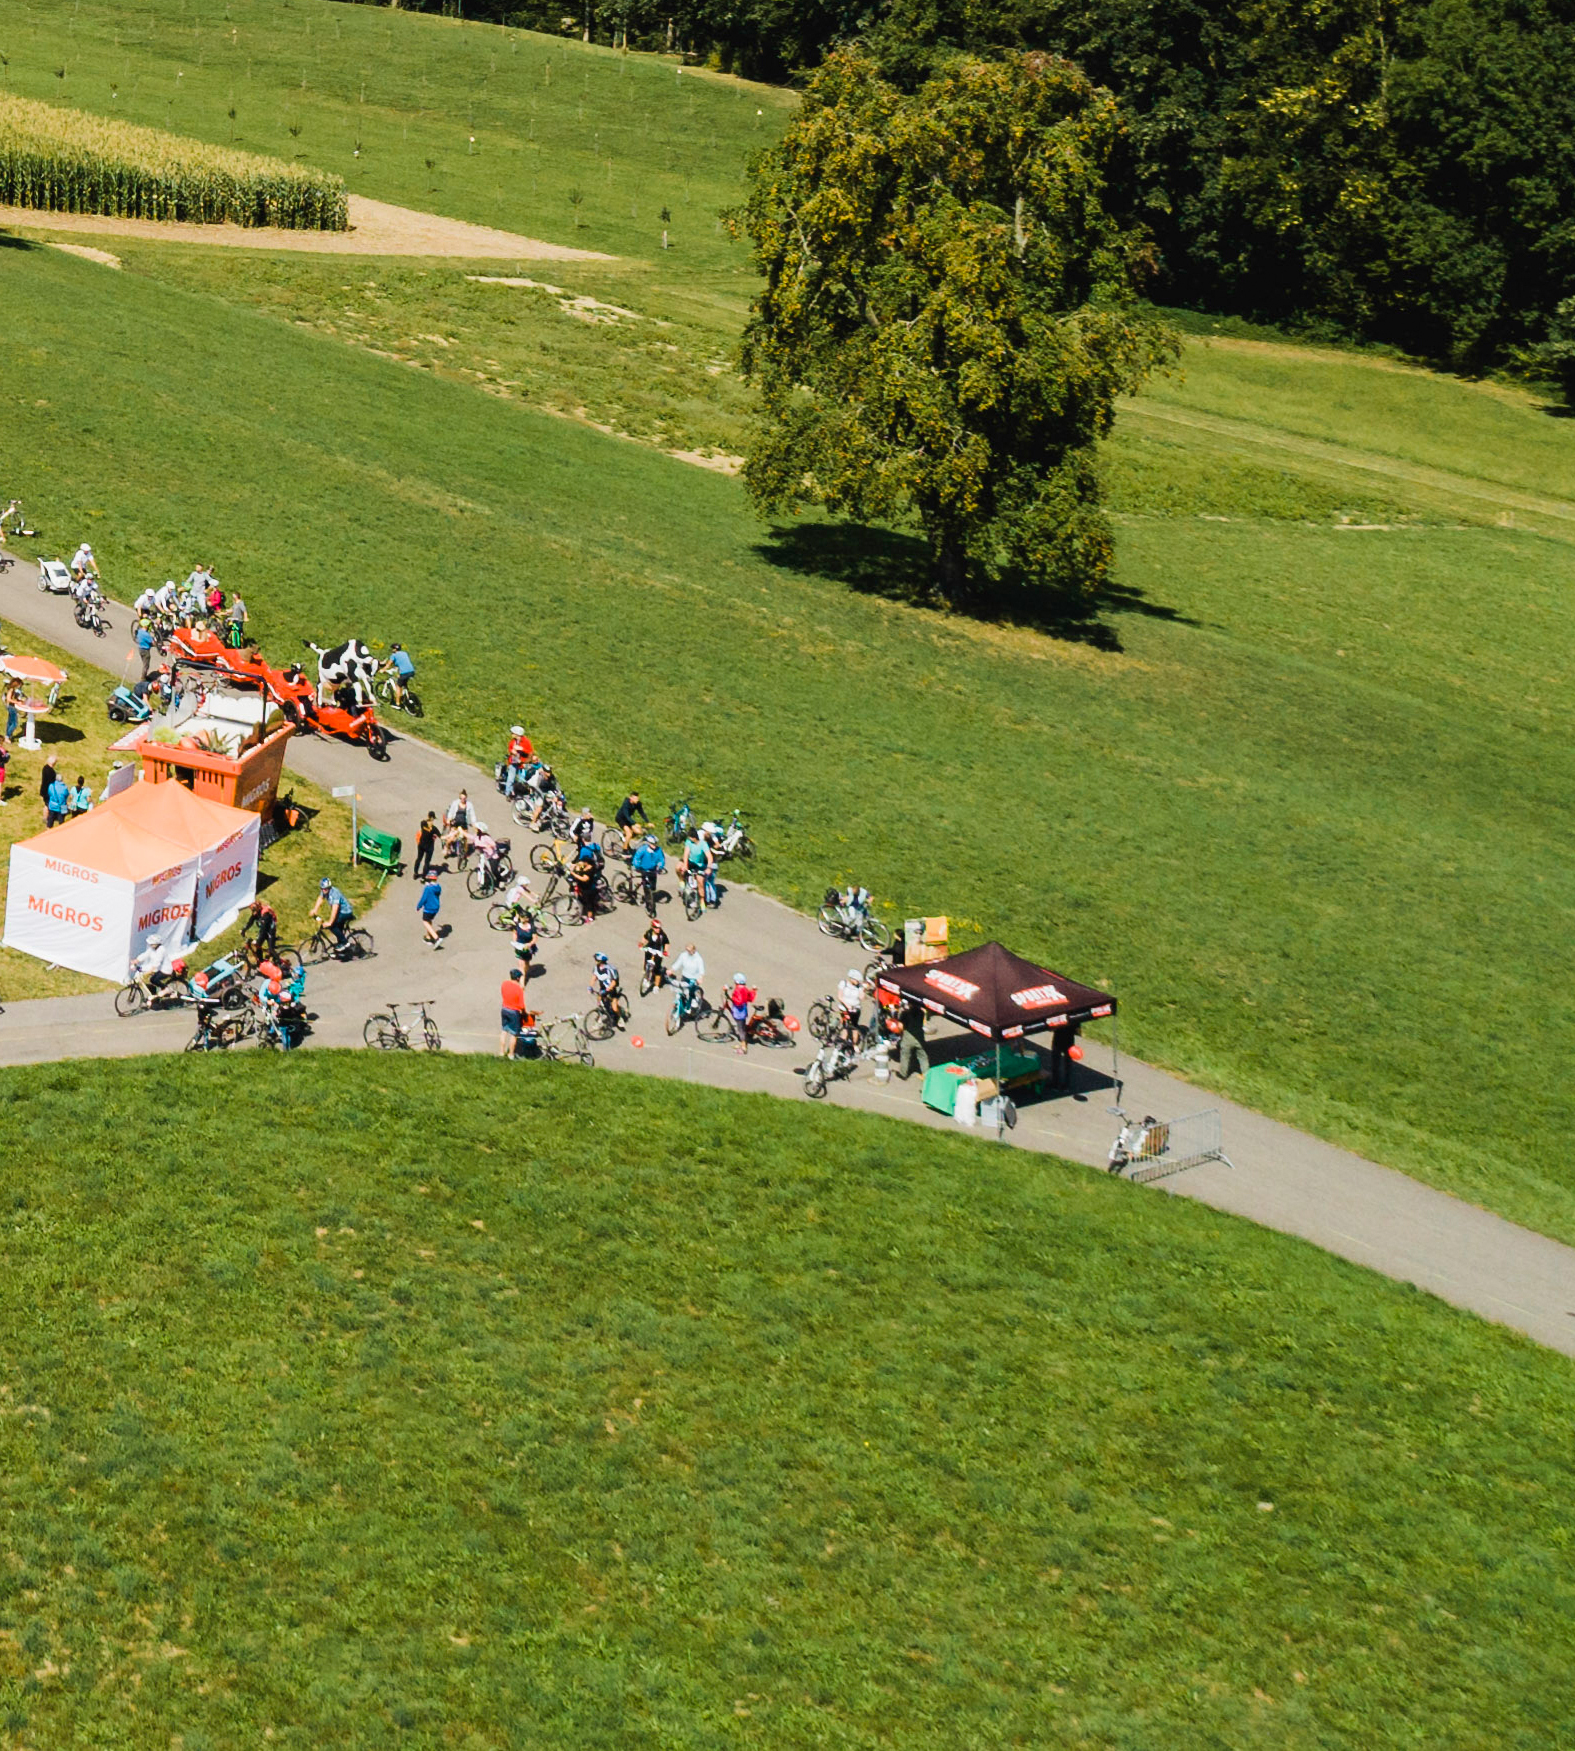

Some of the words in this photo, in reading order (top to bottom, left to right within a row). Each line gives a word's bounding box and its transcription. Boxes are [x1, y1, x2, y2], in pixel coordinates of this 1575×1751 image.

[45, 858, 99, 883] MIGROS
[205, 861, 242, 899] MIGROS
[28, 895, 103, 932] MIGROS
[138, 904, 191, 932] MIGROS
